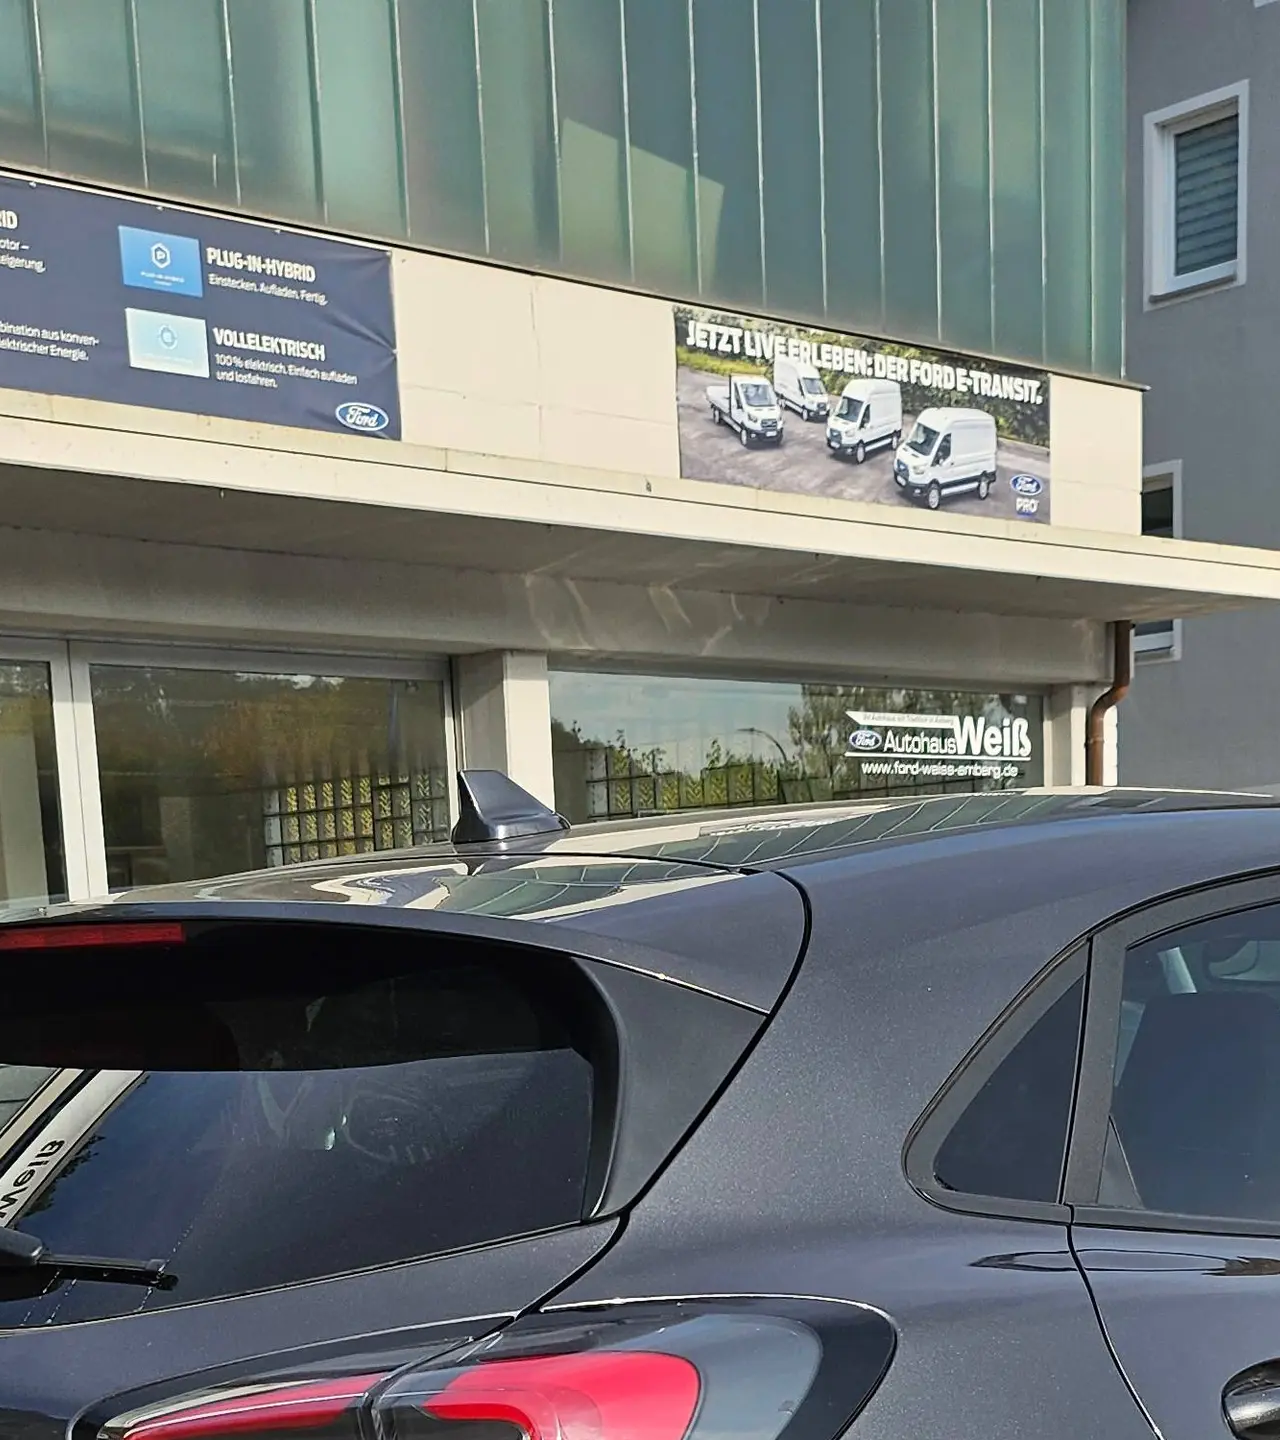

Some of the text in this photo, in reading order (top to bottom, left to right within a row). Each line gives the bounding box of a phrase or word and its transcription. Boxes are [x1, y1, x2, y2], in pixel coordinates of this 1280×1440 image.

[206, 247, 316, 283] PLUG-IN-HYBRID
[208, 273, 259, 293] Einstecken.
[259, 281, 300, 300] Aufladen.
[40, 328, 60, 341] aus
[212, 326, 326, 362] VOLLELEKTRISCH
[49, 343, 90, 362] Energie.
[685, 320, 1043, 405] JETZT LIVE ERLEBEN: DER FORD E-TRANSIT.
[215, 370, 279, 389] und losfahren.
[244, 359, 287, 376] elektrisch.
[287, 363, 320, 380] Einfach
[320, 369, 358, 386] aufladen
[883, 729, 956, 755] Autohaus
[954, 715, 1032, 757] Weiß
[860, 761, 1019, 779] www.ford-weiss-amberg.de
